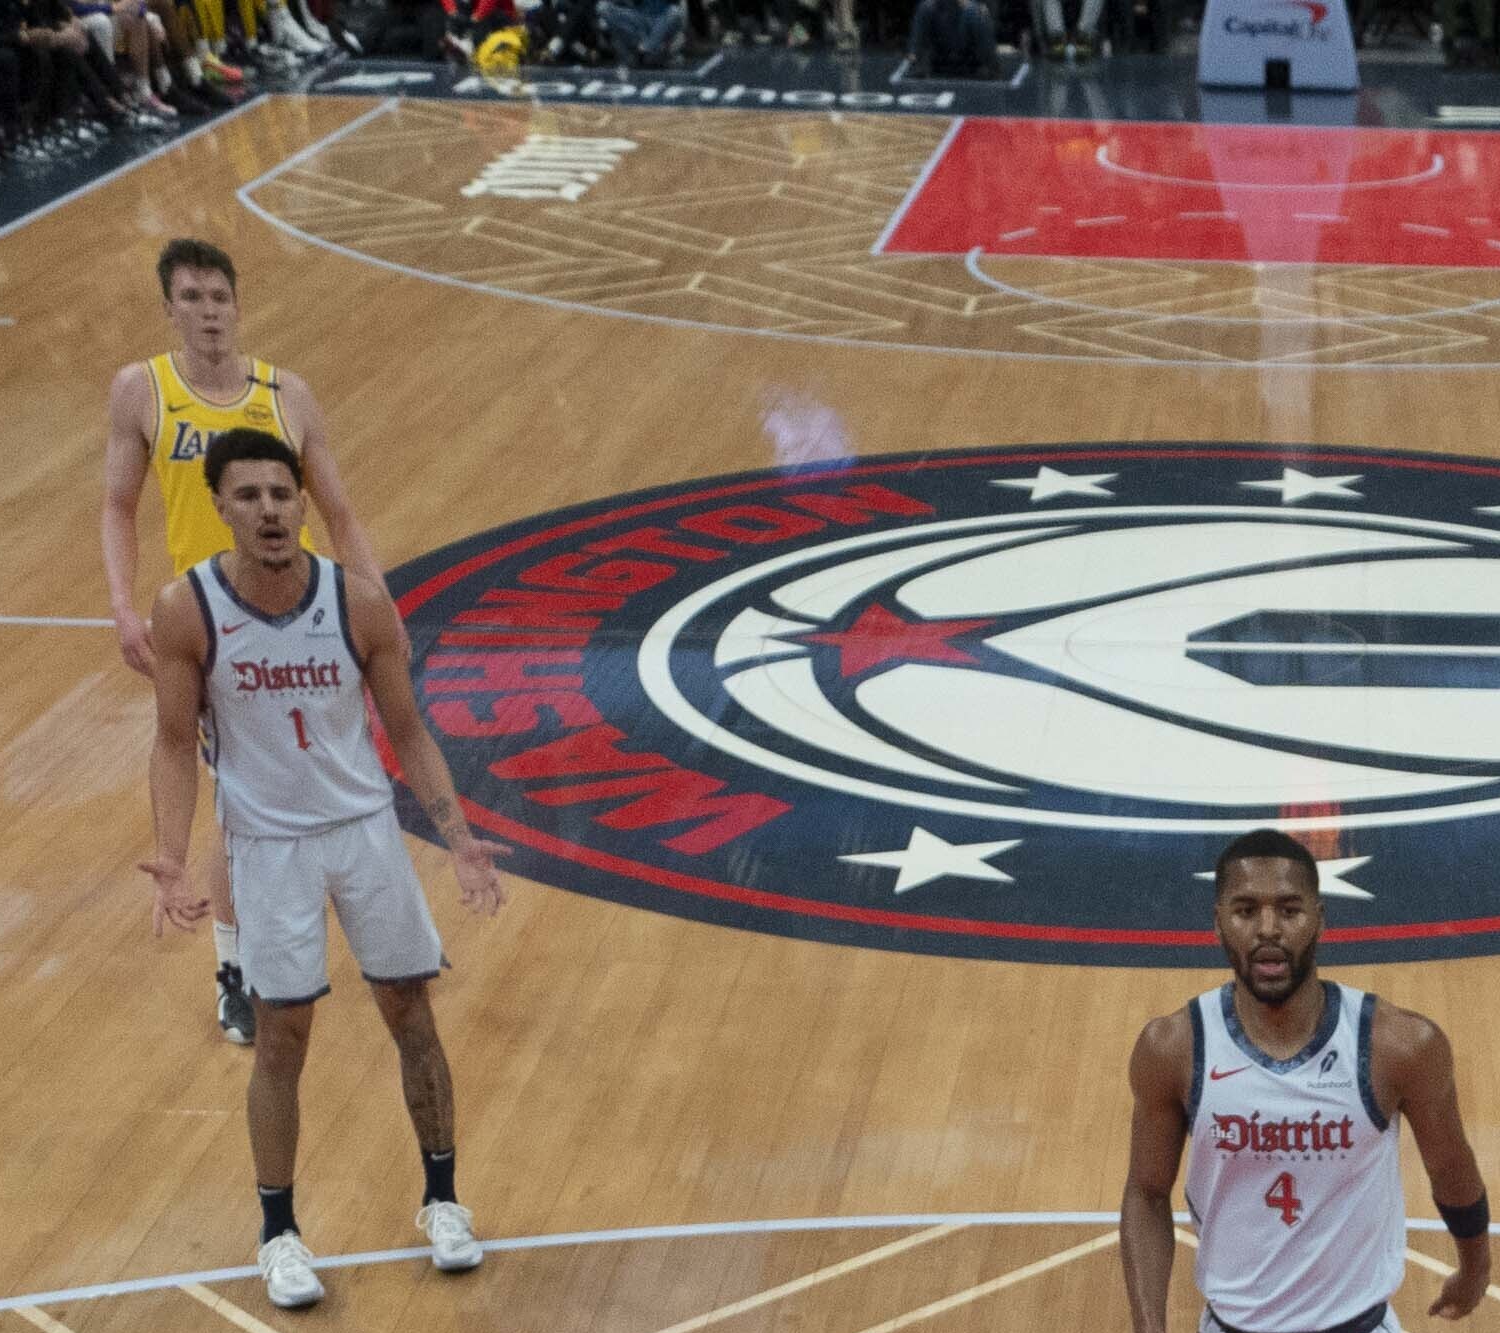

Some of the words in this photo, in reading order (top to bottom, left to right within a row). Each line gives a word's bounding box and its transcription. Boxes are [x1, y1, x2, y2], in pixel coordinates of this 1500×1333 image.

[230, 656, 342, 692] District
[422, 483, 938, 858] WASHINGTON
[287, 706, 314, 751] 1
[1211, 1109, 1356, 1154] District
[1264, 1170, 1303, 1228] 4
